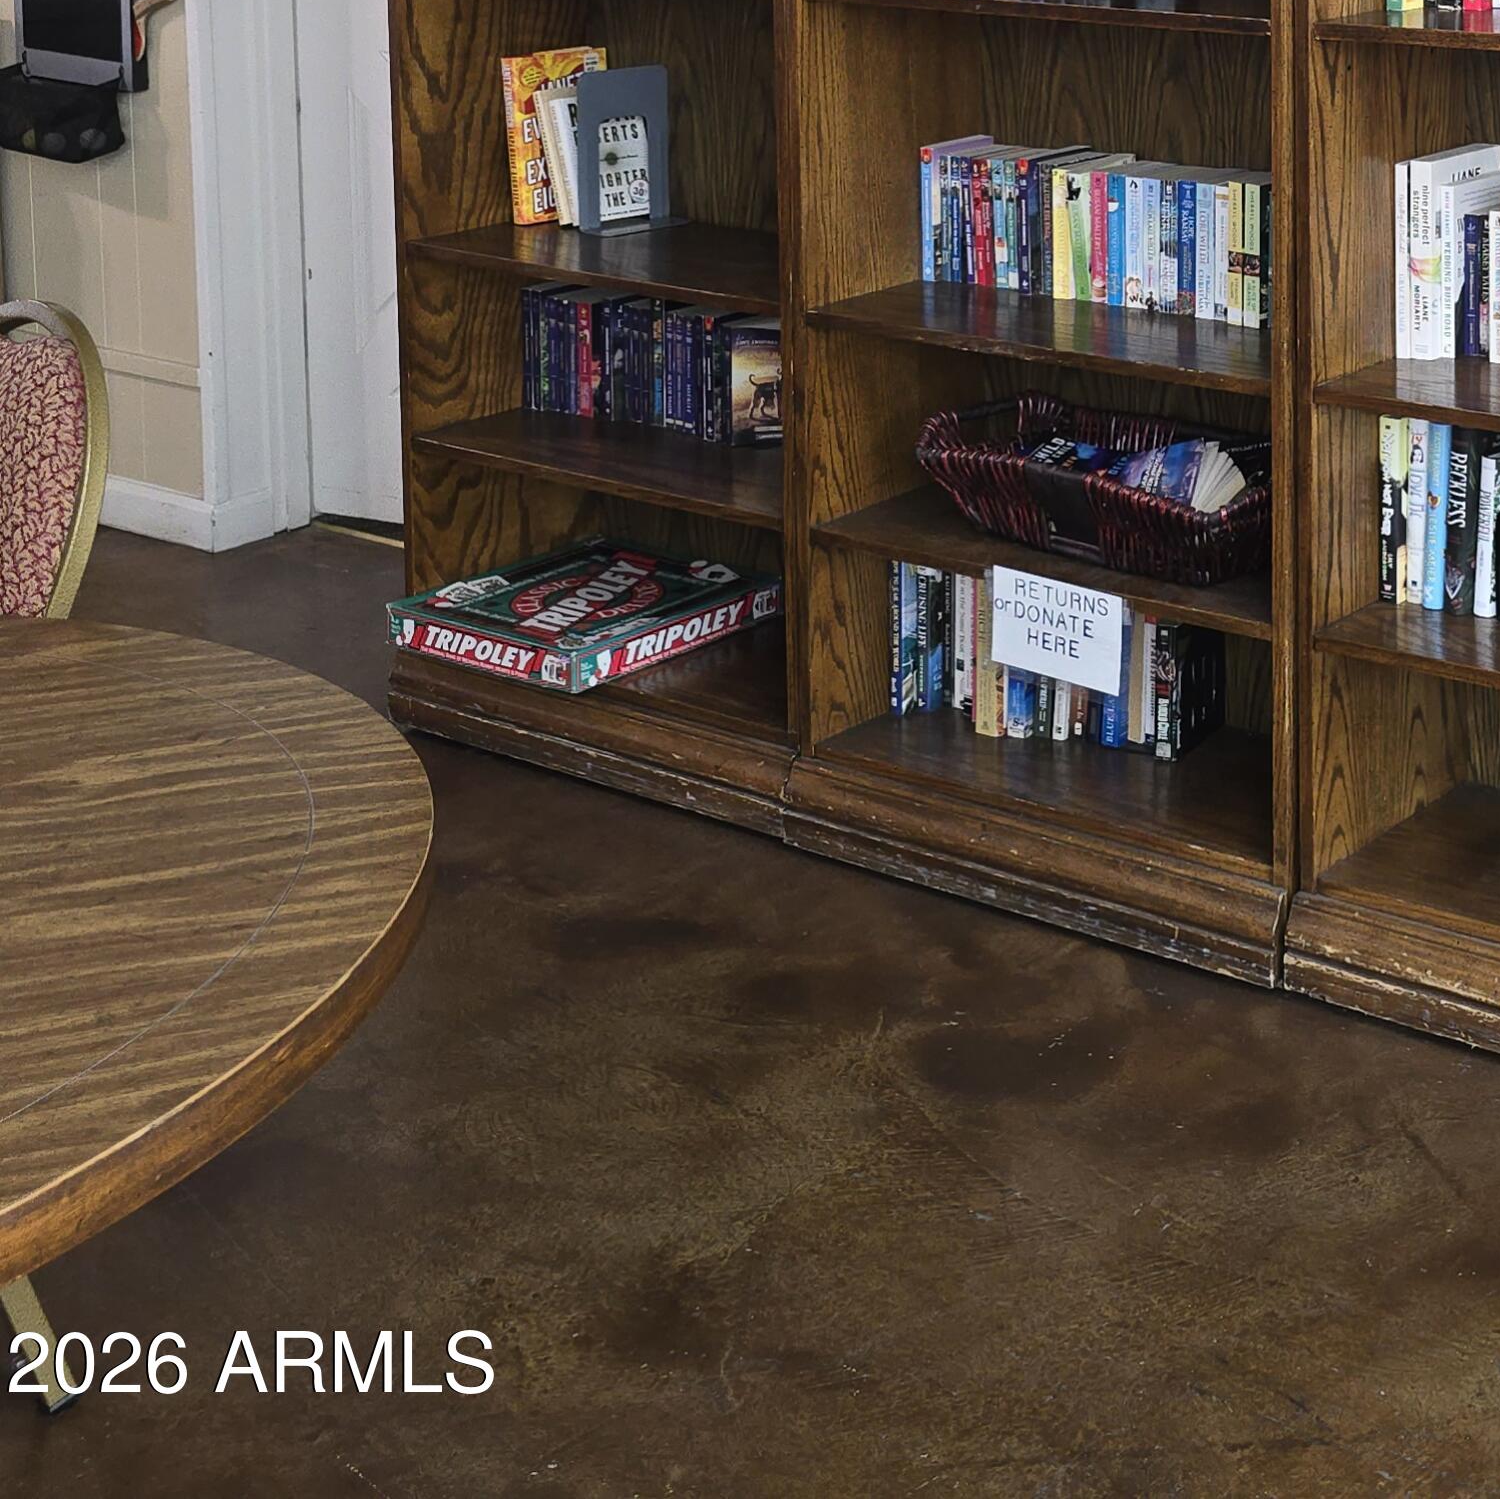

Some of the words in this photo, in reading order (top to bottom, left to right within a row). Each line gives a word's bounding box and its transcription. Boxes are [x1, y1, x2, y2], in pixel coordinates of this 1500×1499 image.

[1412, 190, 1421, 239] strangers
[1422, 186, 1430, 207] nine
[1421, 209, 1431, 245] perfect
[1413, 285, 1421, 332] MORIARTY
[1448, 451, 1468, 528] RECKLESS
[520, 560, 650, 632] TRIPOLEY
[918, 576, 927, 624] CRUISING
[994, 597, 1011, 611] or
[1013, 601, 1095, 639] DONATE
[1014, 578, 1109, 617] RETURNS
[425, 624, 537, 671] TRIPOLEY
[624, 601, 745, 665] TRIPOLEY
[1027, 628, 1080, 659] HERE
